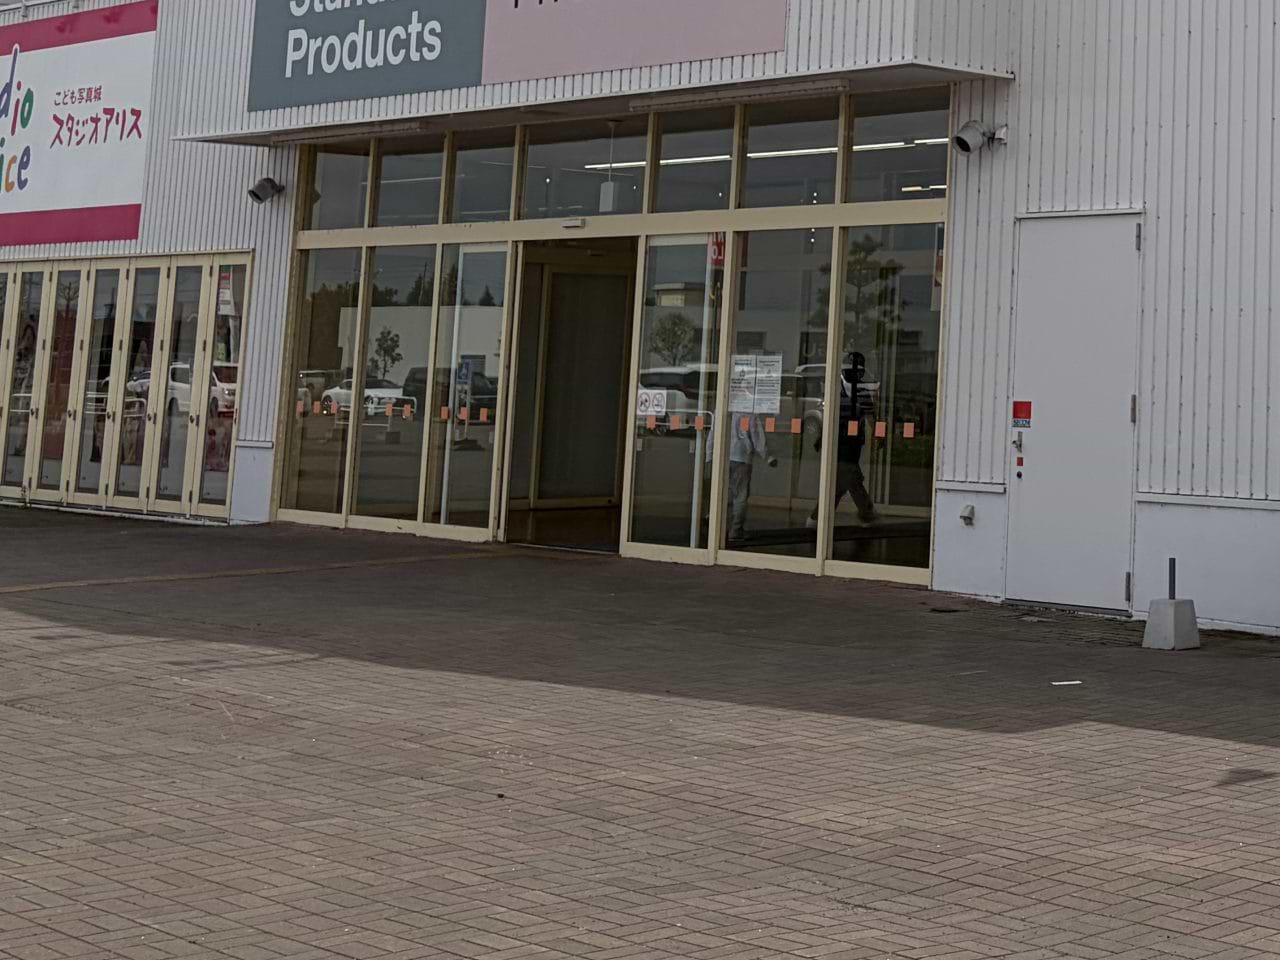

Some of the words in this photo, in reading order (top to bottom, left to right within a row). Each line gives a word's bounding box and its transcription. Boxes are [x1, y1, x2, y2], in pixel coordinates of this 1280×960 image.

[284, 10, 442, 79] Products
[50, 107, 143, 149] スタジオアリス
